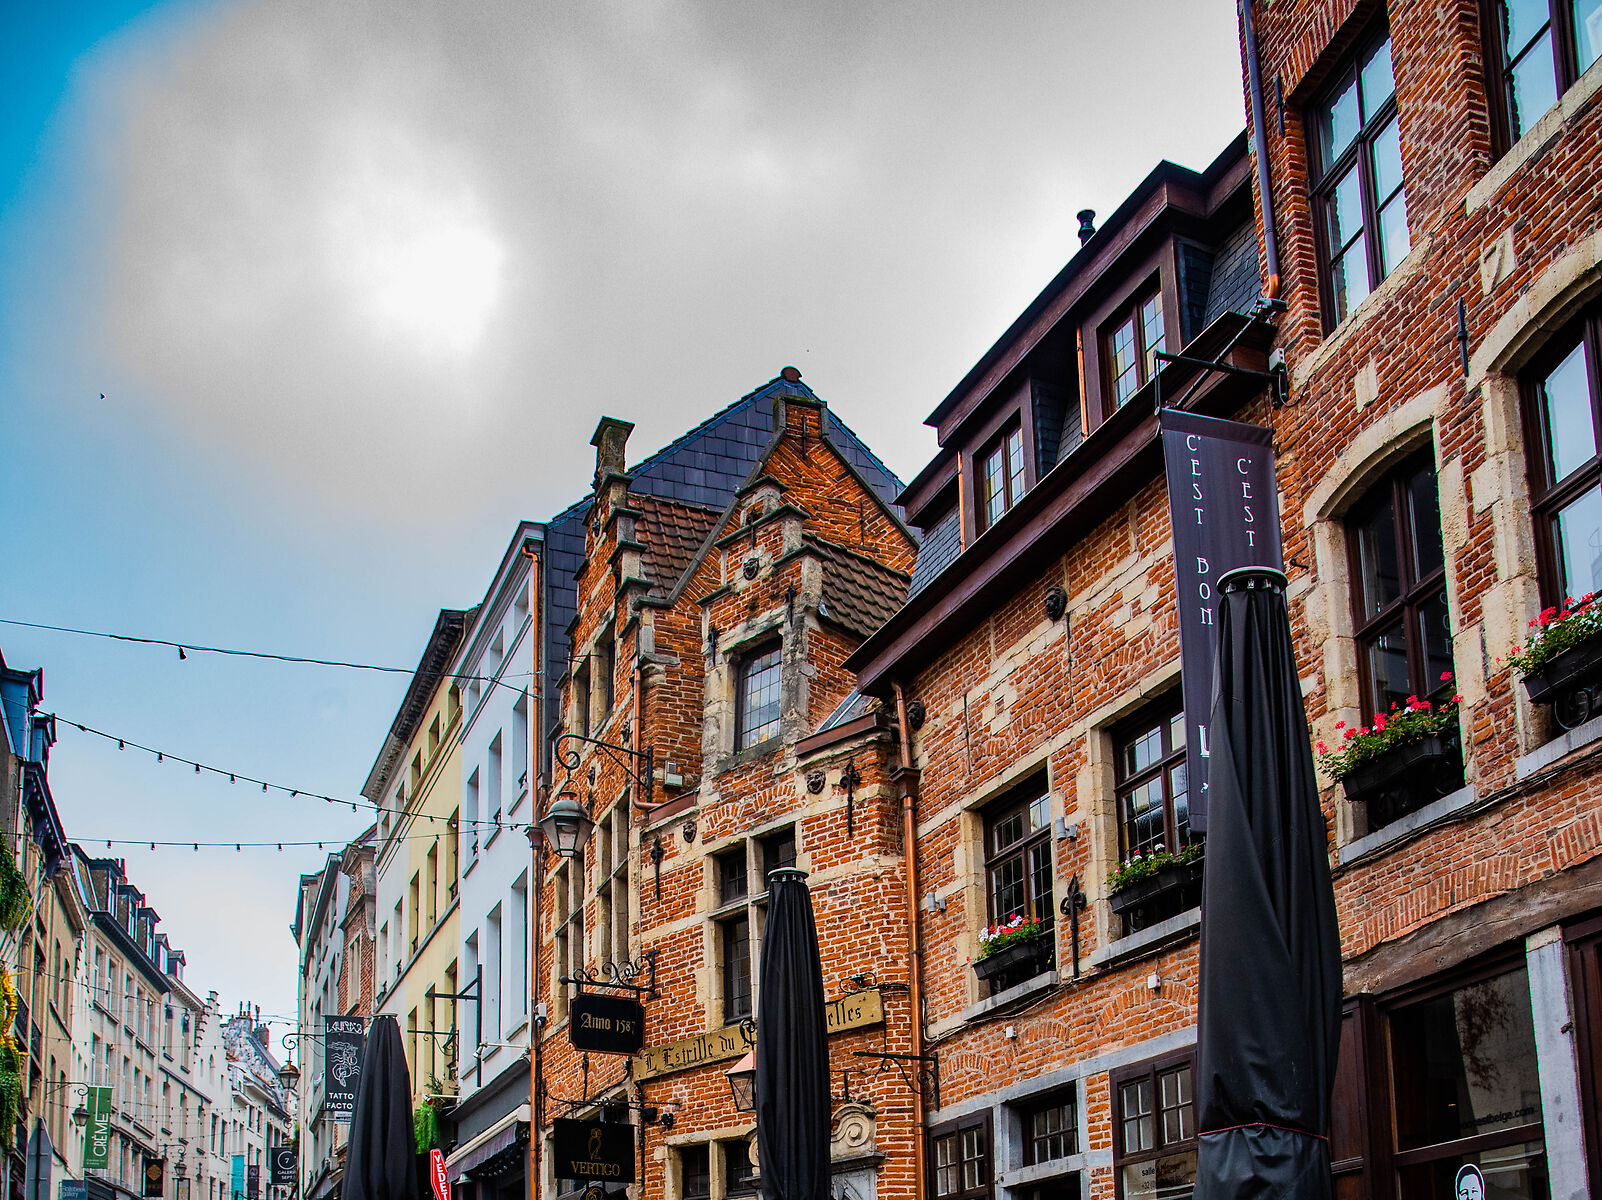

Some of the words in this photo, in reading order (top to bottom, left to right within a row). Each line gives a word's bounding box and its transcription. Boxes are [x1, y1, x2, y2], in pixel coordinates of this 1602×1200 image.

[1236, 457, 1256, 547] C'EST
[1185, 433, 1204, 526] C'EST
[1196, 556, 1214, 626] BON
[580, 1012, 611, 1030] Anno
[615, 1019, 636, 1036] 1587
[827, 1002, 862, 1028] elles
[719, 1035, 735, 1052] du
[326, 1102, 353, 1110] FACTO
[328, 1092, 354, 1100] TATTO
[570, 1160, 621, 1176] VERTIGO
